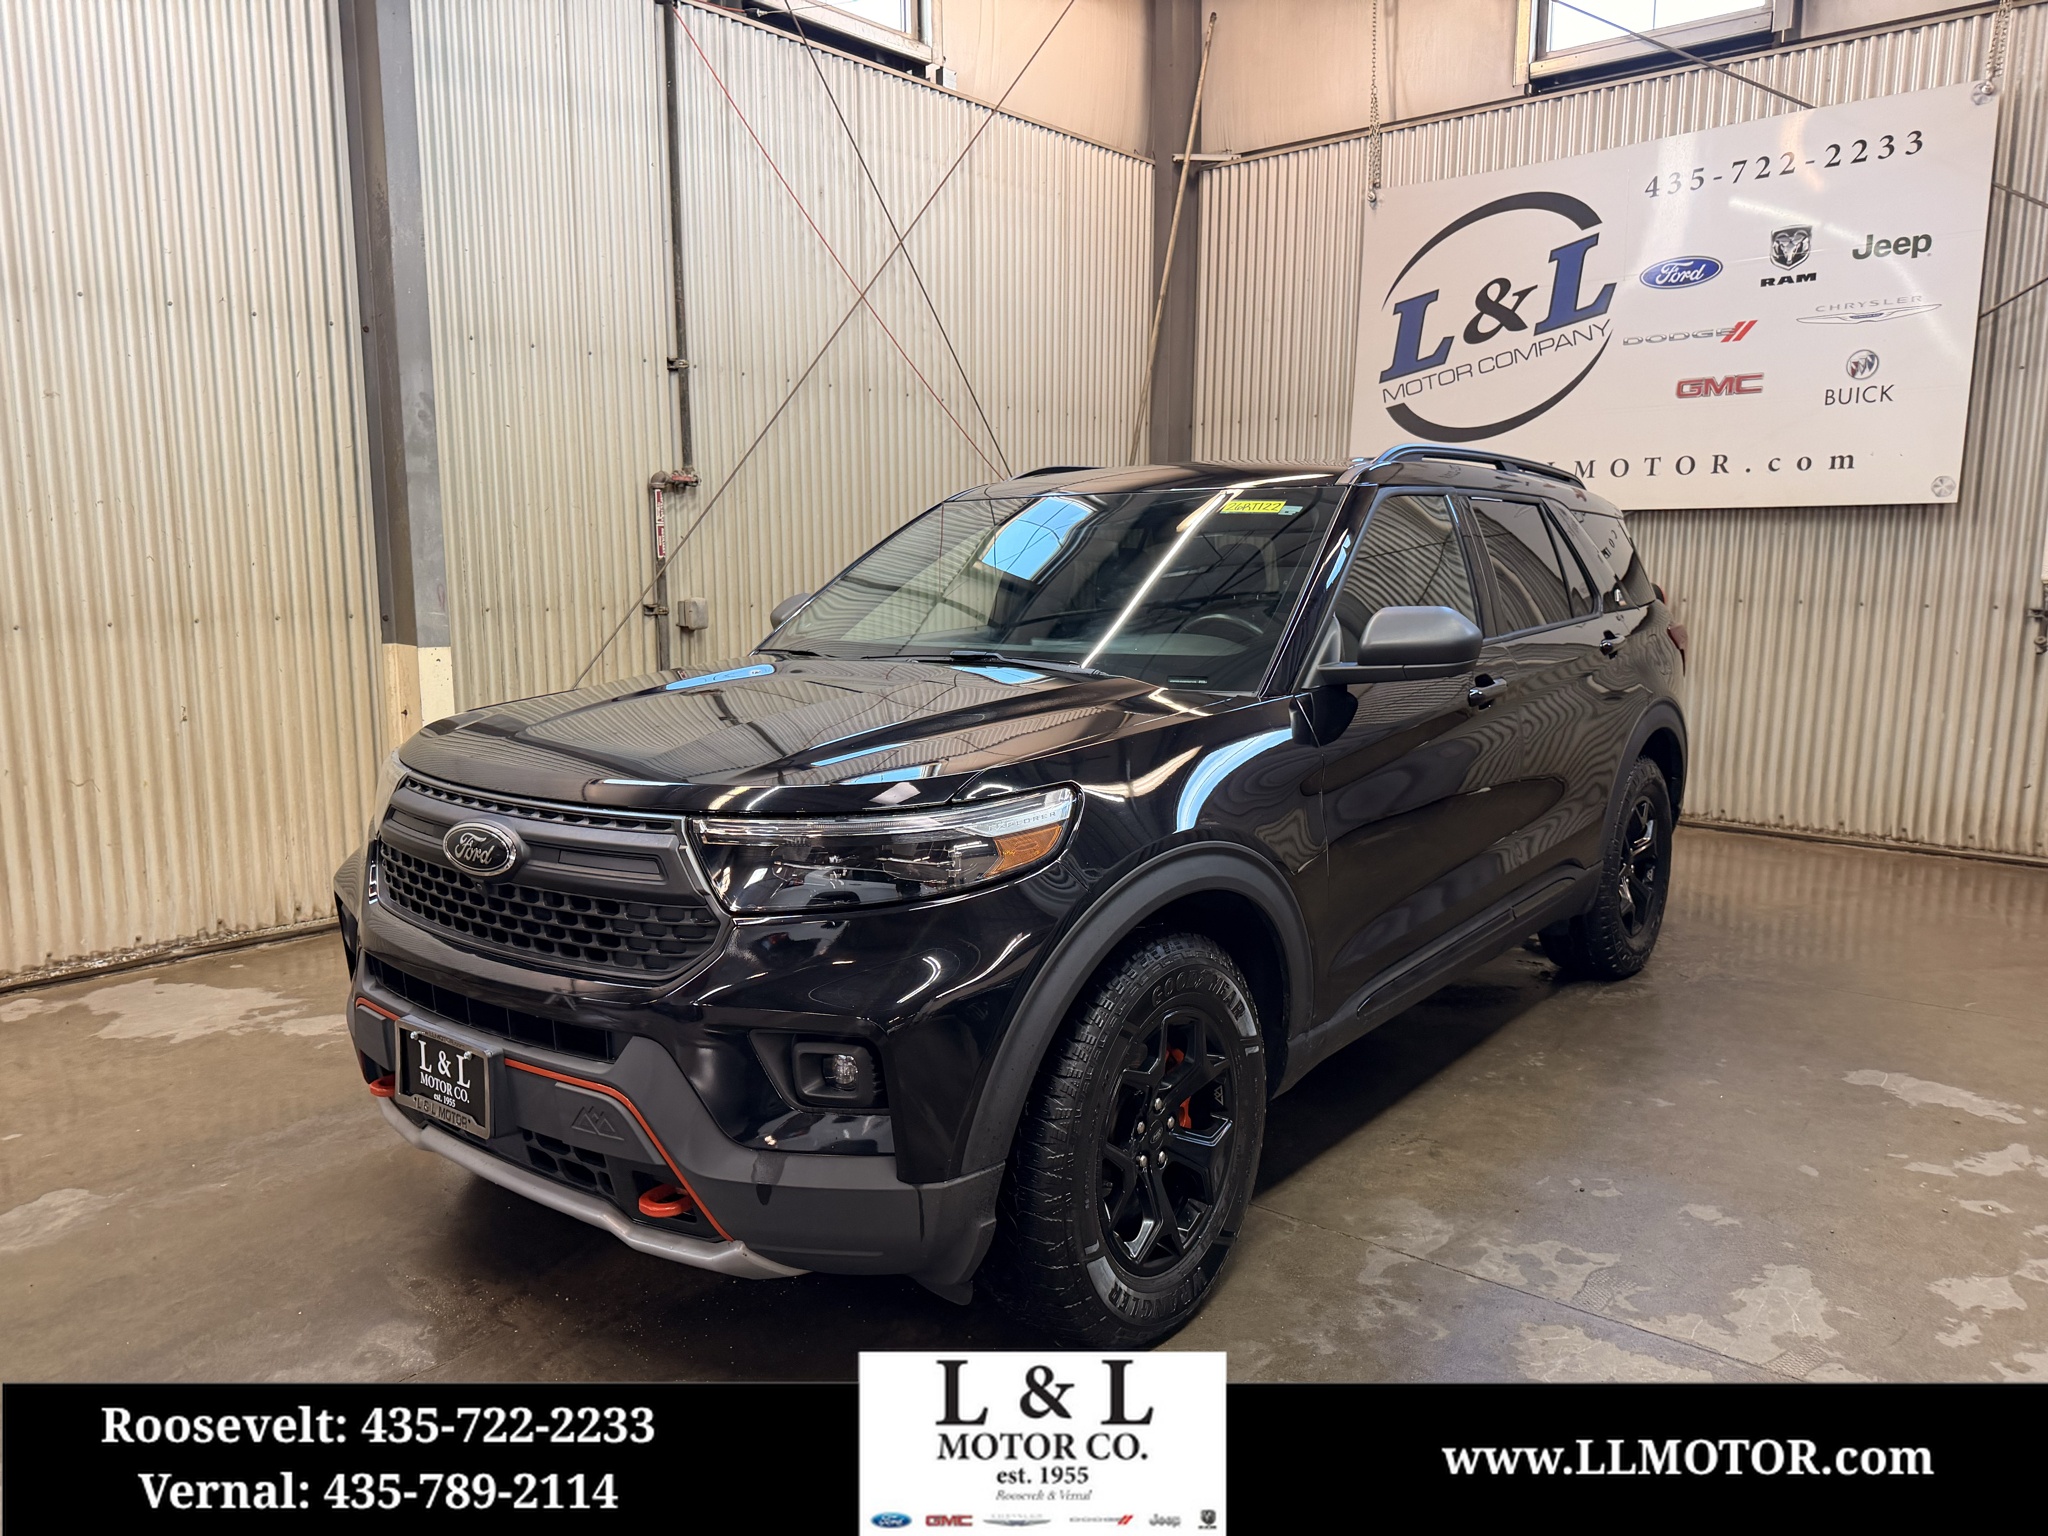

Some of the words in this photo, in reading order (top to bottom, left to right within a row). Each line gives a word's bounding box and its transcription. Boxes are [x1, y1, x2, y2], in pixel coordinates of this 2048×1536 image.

[1644, 130, 1924, 198] 435-722-2233
[1852, 233, 1932, 259] Jeep
[1655, 261, 1705, 286] Ford
[1760, 272, 1817, 288] RAM
[1815, 295, 1923, 312] CHRYSLER
[1622, 327, 1737, 346] DODGE
[1382, 363, 1474, 403] MOTOR
[1478, 318, 1611, 375] COMPANY
[1675, 372, 1765, 399] GMC
[1824, 384, 1895, 406] BUICK
[1547, 453, 1855, 479] MOTOR.com
[454, 832, 495, 865] Ford
[418, 1040, 433, 1073] L
[437, 1050, 451, 1078] &
[456, 1054, 471, 1088] L
[420, 1071, 453, 1097] MOTOR
[453, 1086, 470, 1104] CO.
[443, 1096, 456, 1108] 1955
[438, 1107, 468, 1129] MOTOR
